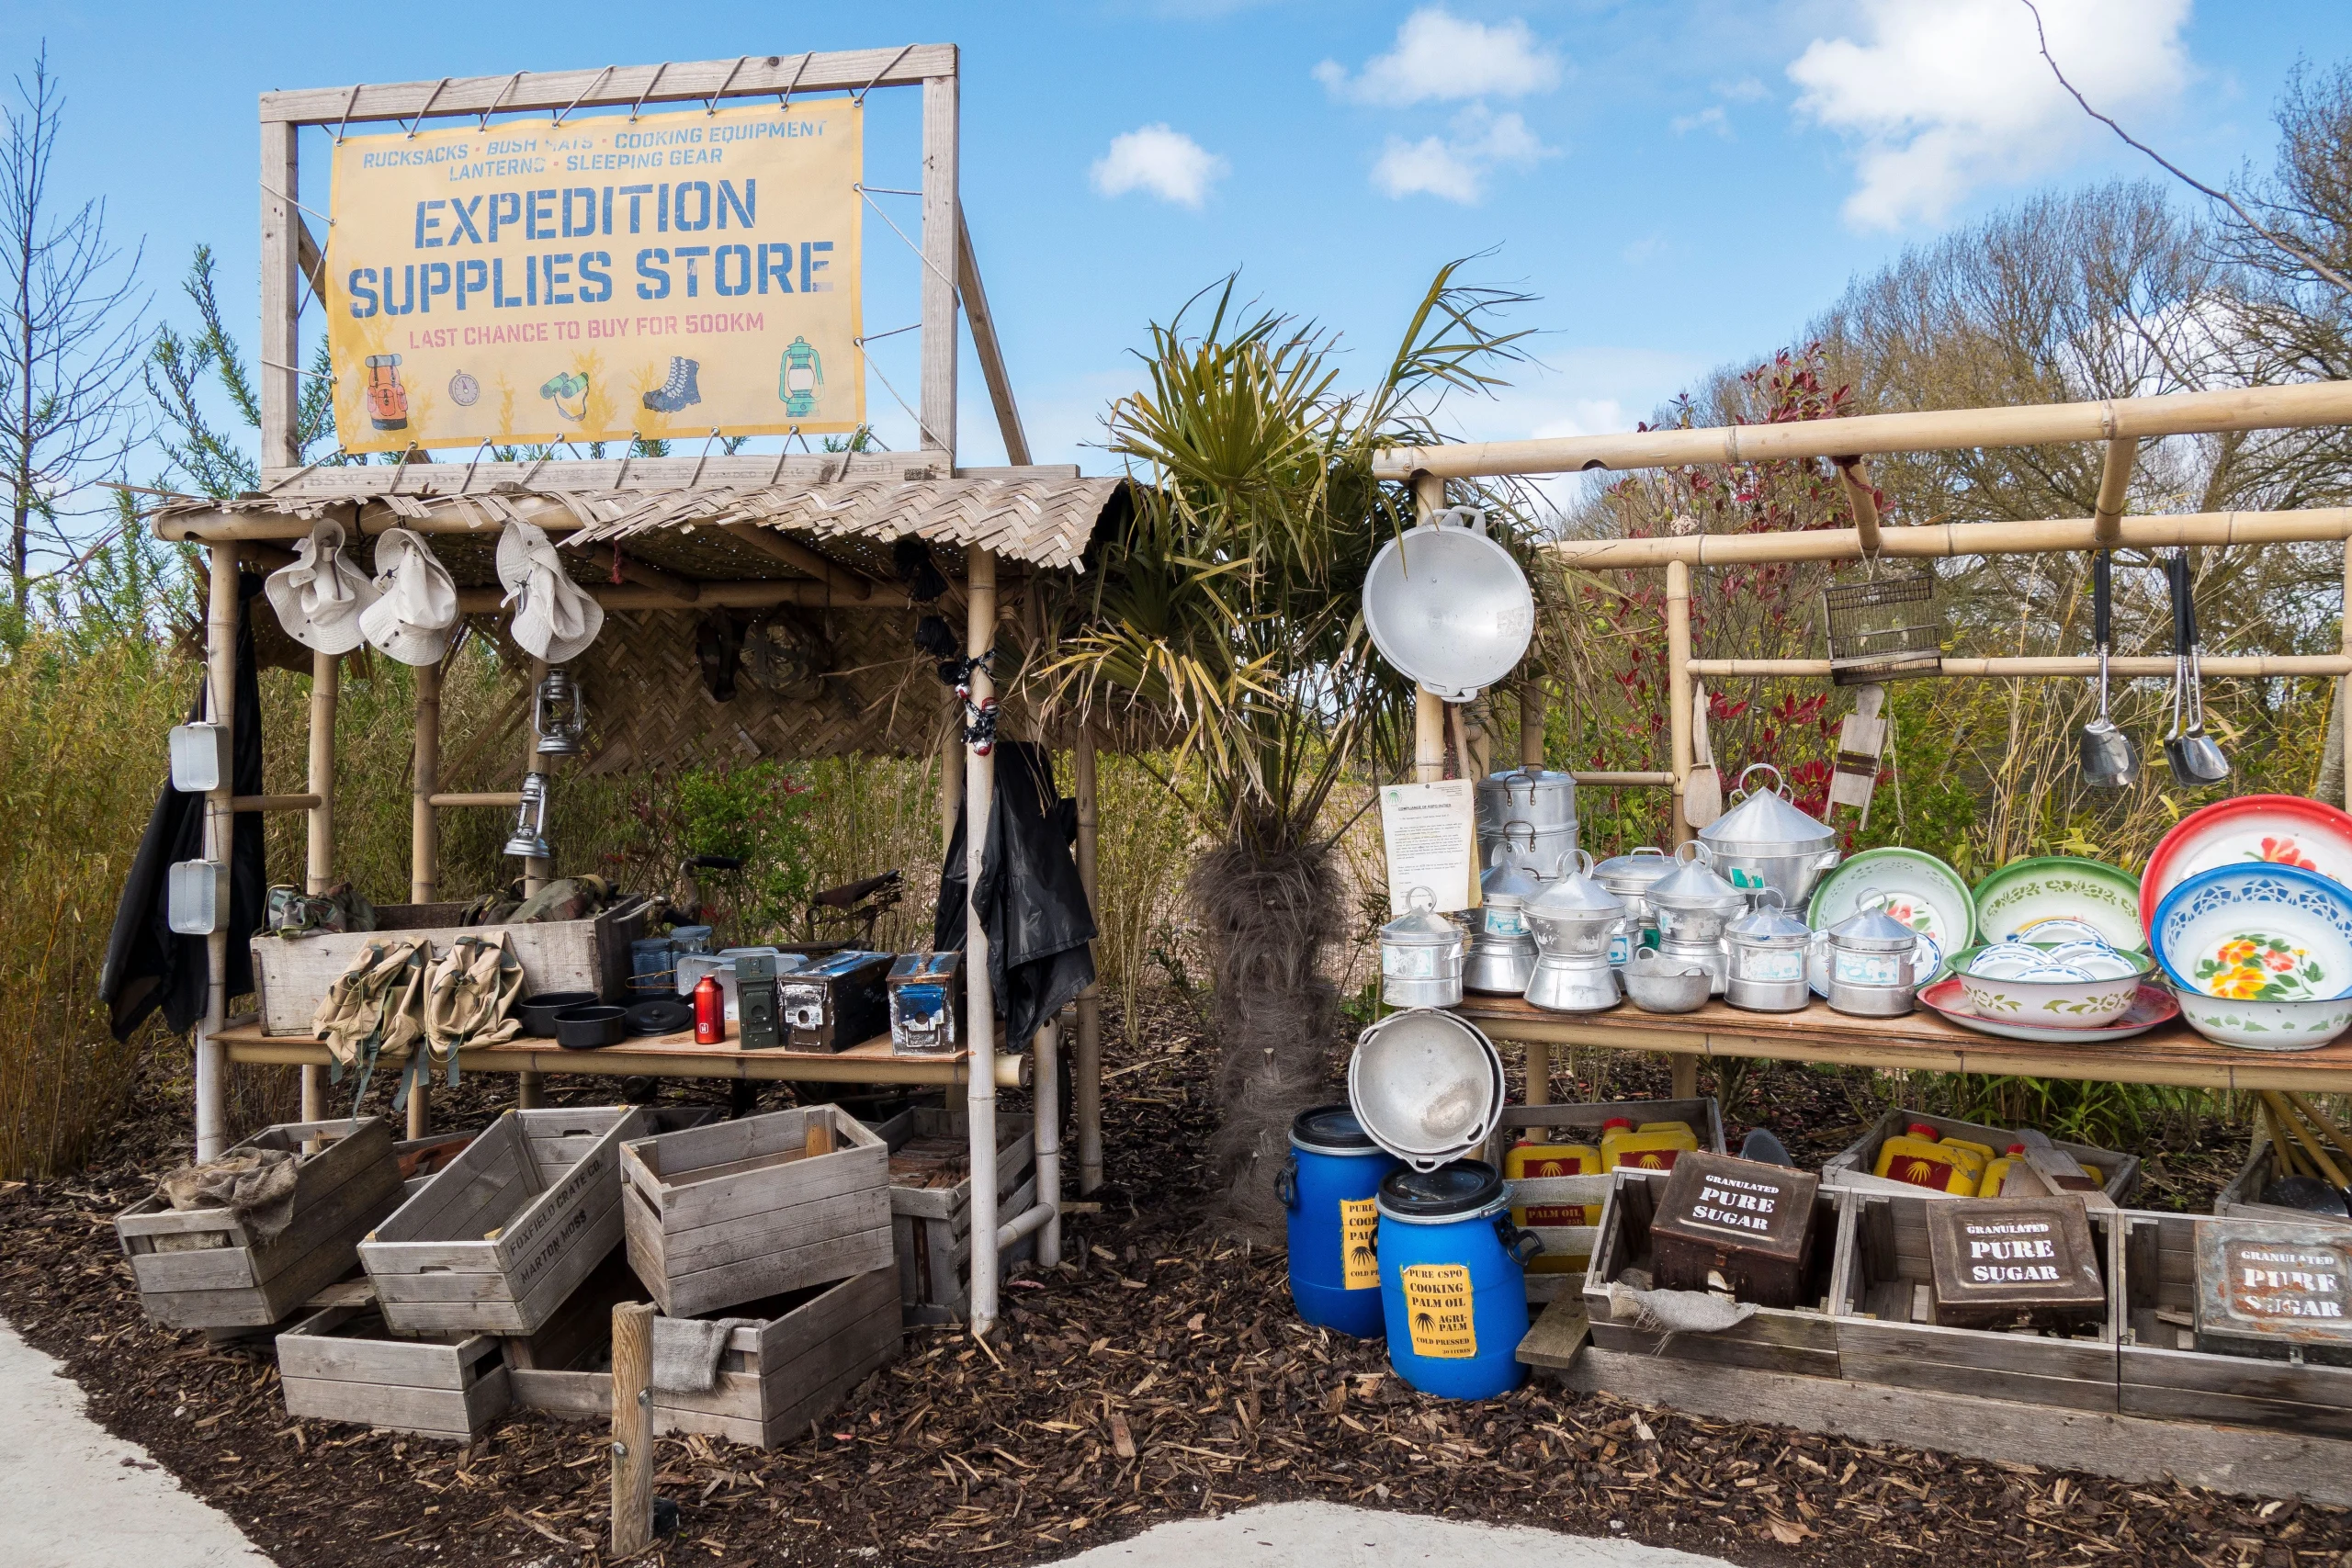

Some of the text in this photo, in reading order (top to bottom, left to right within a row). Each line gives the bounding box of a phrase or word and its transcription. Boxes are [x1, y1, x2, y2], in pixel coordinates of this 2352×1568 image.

[363, 143, 469, 169] RUCKSACKS
[486, 138, 537, 156] BUSH
[615, 127, 704, 150] COOKING
[709, 120, 828, 144] EQUIPMENT
[449, 147, 723, 182] LANTERNS SLEEPING GEAR
[414, 177, 758, 249] EXPEDITION
[348, 240, 834, 320] SUPPLIES STORE
[409, 312, 765, 350] LAST CHANCE TO BUY FOR 500KM
[1705, 1174, 1780, 1194] GRANULATED
[509, 1159, 604, 1257] FOXFIELD CRATE CO.
[1349, 1203, 1374, 1213] PURE
[1699, 1186, 1775, 1213] PURE
[1528, 1208, 1581, 1219] PALM OIL
[1692, 1205, 1769, 1231] SUGAR
[1966, 1224, 2050, 1235] GRANULATED
[519, 1209, 588, 1284] MARTON MOSS
[1970, 1239, 2055, 1259] PURE
[2241, 1250, 2335, 1265] GRANULATED
[1409, 1269, 1464, 1279] PURE CSPO
[1973, 1266, 2060, 1281] SUGAR
[2244, 1268, 2339, 1292] PURE
[1409, 1282, 1464, 1294] COOKING
[1412, 1297, 1466, 1308] PALM OIL
[1439, 1314, 1467, 1324] AGRI-
[1439, 1322, 1468, 1332] PALM
[1416, 1337, 1470, 1346] COLD PRESSED
